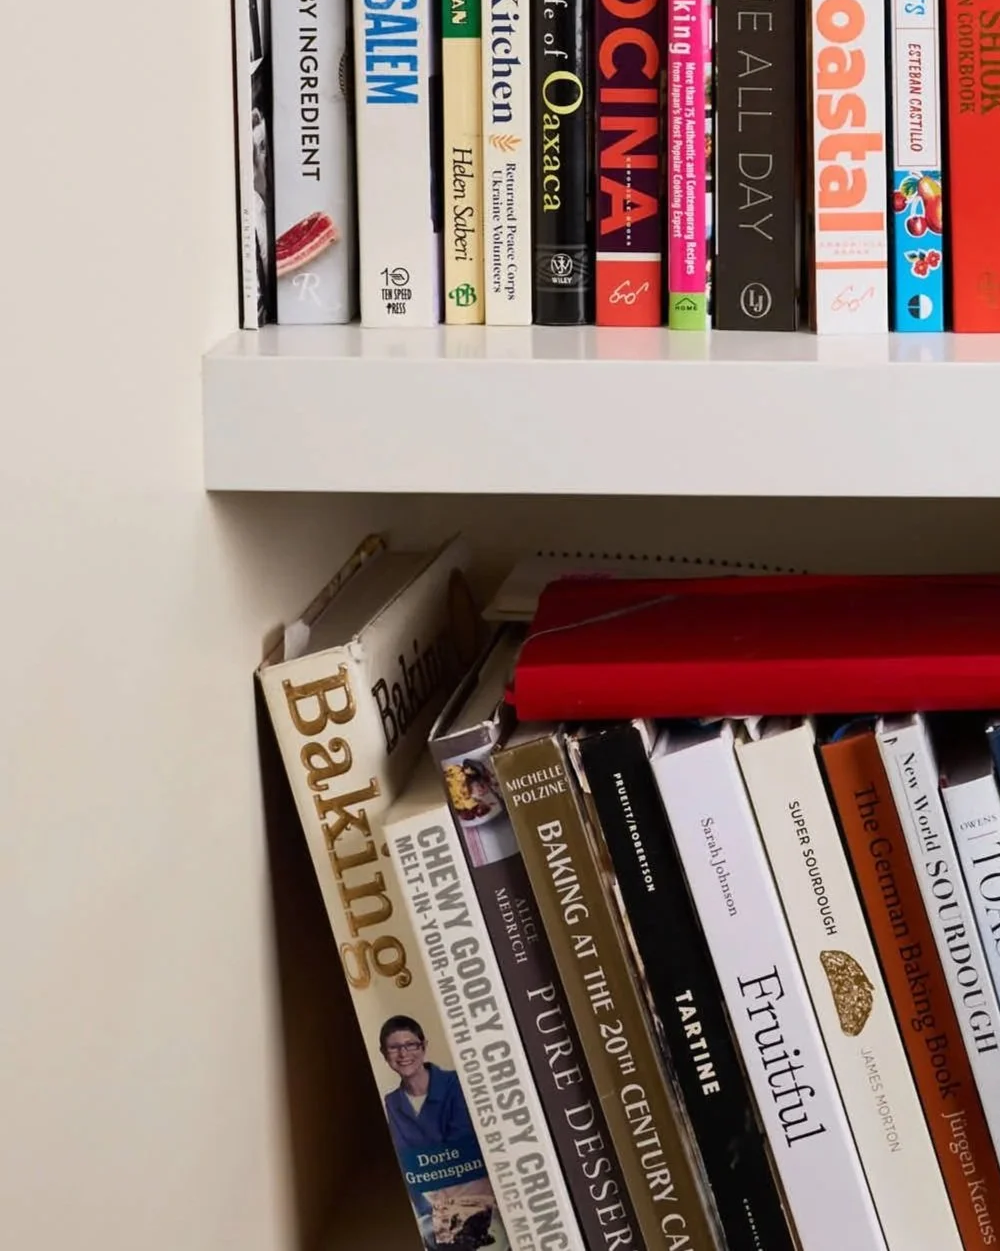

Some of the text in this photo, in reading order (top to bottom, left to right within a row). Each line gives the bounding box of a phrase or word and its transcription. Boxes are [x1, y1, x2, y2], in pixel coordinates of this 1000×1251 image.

[543, 33, 569, 60] of
[738, 50, 773, 133] ALL
[908, 43, 923, 152] ESTEBAN CASTILLO
[957, 12, 975, 114] COOKBOOK
[298, 28, 320, 182] INGREDIENT
[543, 70, 584, 214] Oaxaca
[452, 147, 473, 261] Helen Saberi
[683, 62, 697, 275] More than 75 Authentic and Contemporary Recipes
[738, 153, 773, 240] DAY
[492, 170, 503, 294] Ukraine Volunteers
[504, 162, 518, 301] Returned Peace Corps
[282, 661, 412, 989] Baking
[505, 764, 564, 792] MICHELLE
[700, 817, 738, 918] Sarah Johnson
[788, 800, 838, 936] SUPER SOURDOUGH
[899, 752, 998, 1054] New World SOURDOUGH
[417, 824, 537, 1143] CHEWY GOOEY CRISPY
[526, 981, 583, 1091] PURE
[854, 786, 996, 1245] The German Baking Book Jürgen Krauss
[675, 989, 720, 1096] TARTINE
[737, 965, 827, 1148] Fruitful
[406, 1158, 484, 1185] Greenspan
[416, 1145, 461, 1166] Dorie
